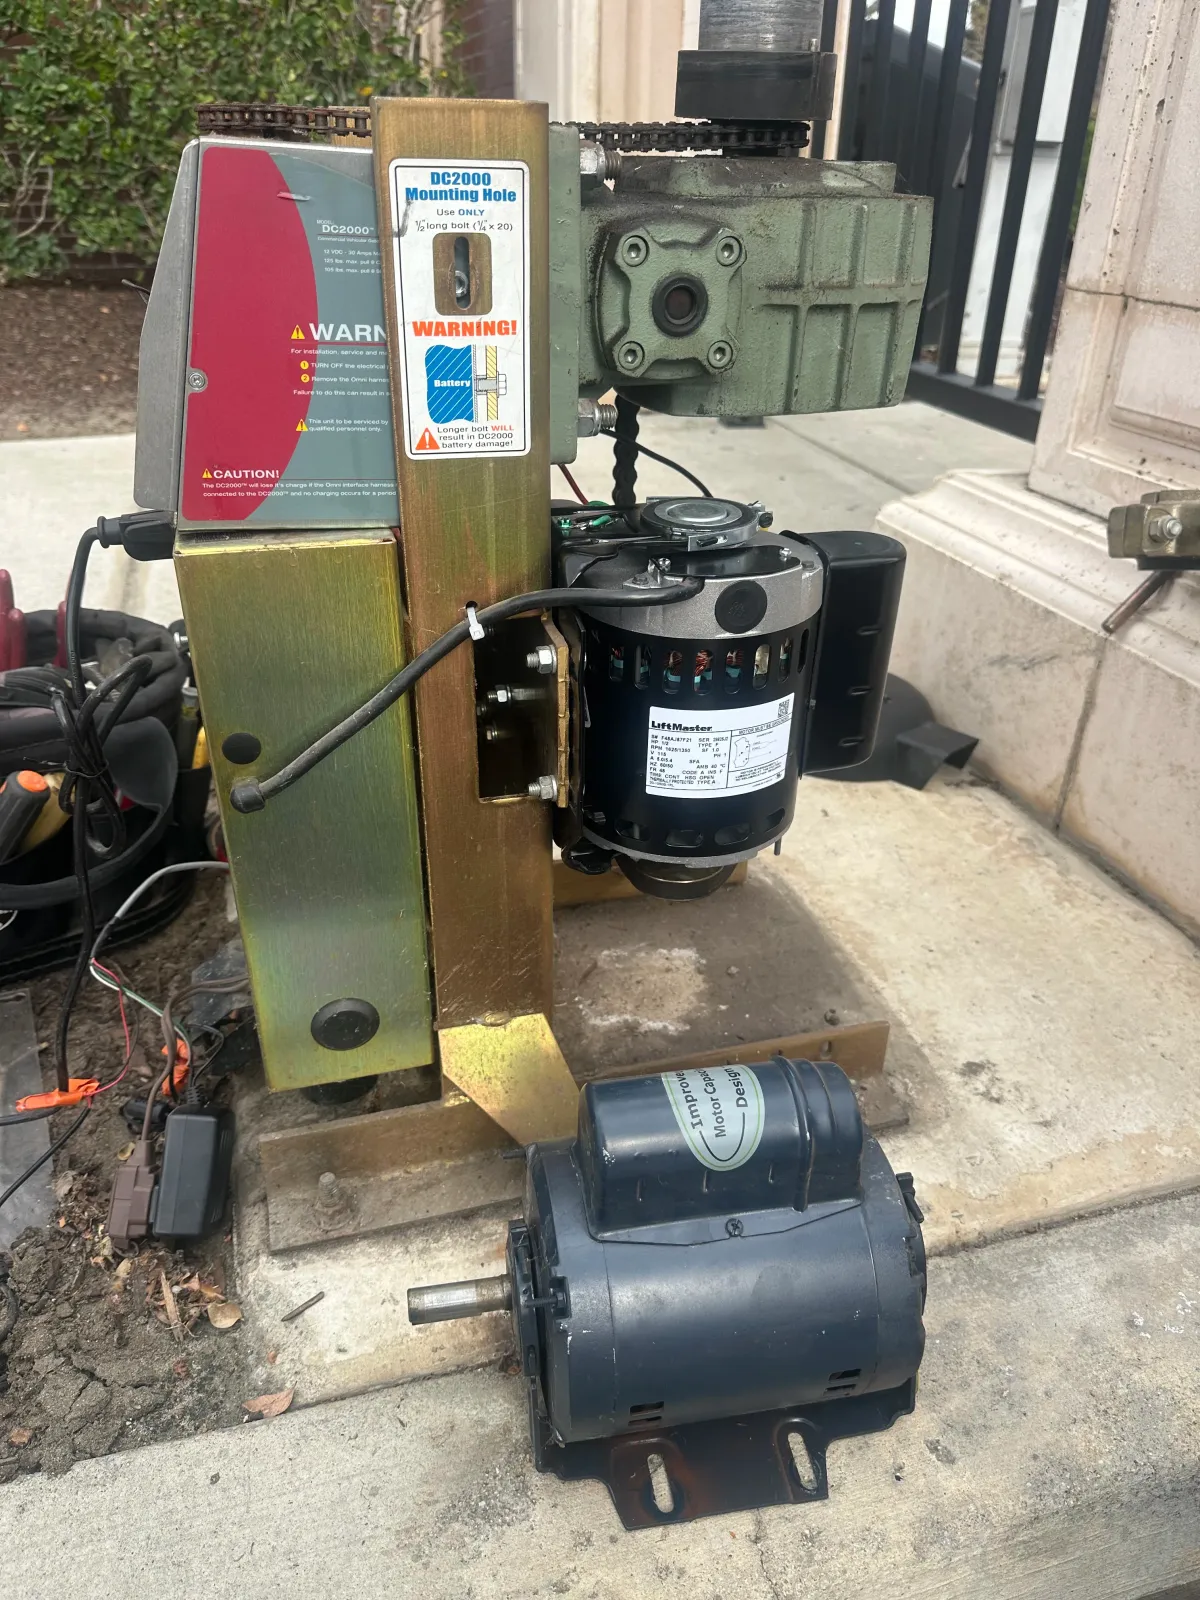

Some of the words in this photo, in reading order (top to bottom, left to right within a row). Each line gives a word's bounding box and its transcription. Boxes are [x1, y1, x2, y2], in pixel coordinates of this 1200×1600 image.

[431, 172, 491, 185] DC2000
[406, 188, 478, 202] Mounting
[483, 188, 516, 202] Hole
[426, 221, 447, 230] long
[451, 221, 469, 229] bolt
[497, 223, 513, 231] 20)
[412, 320, 517, 336] WARNING!
[434, 379, 470, 387] Battery
[442, 440, 472, 448] battery
[476, 440, 512, 448] damage!
[214, 470, 279, 479] CAUTION!
[651, 721, 712, 732] LiftMaster
[675, 1070, 704, 1129] Improve
[711, 1097, 726, 1138] Motor
